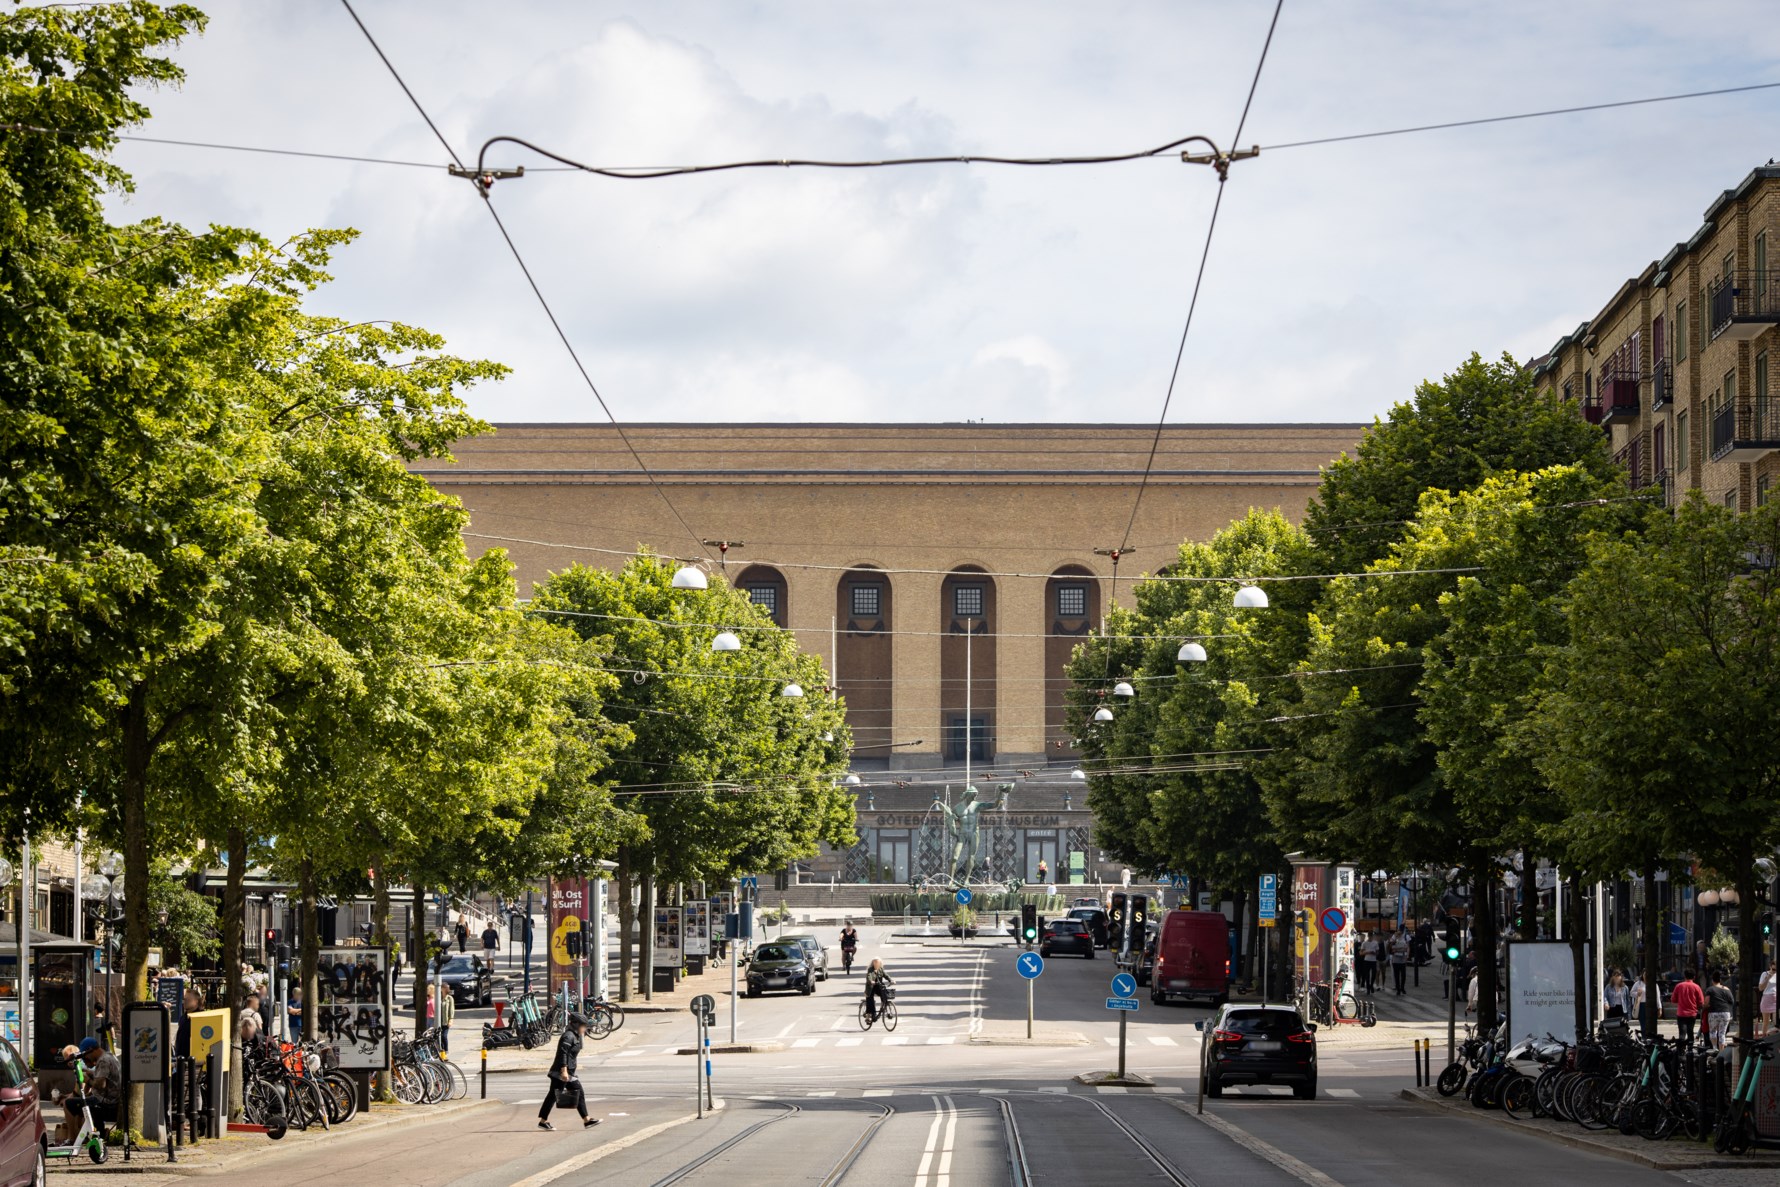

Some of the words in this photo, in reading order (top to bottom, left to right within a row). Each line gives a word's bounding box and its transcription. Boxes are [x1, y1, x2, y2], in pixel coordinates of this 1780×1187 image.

[877, 813, 945, 826] GÖTEBORG
[980, 815, 1059, 826] NSTMUSEUM
[1263, 875, 1274, 889] P
[1303, 882, 1318, 891] Ost
[566, 890, 582, 899] Ost
[552, 900, 558, 909] &
[559, 899, 582, 909] Surf!
[1113, 910, 1121, 921] S
[1135, 911, 1143, 922] S
[1523, 989, 1538, 997] Ride
[1538, 990, 1553, 999] your
[1553, 989, 1566, 997] bike
[1530, 999, 1548, 1008] might
[1548, 1000, 1557, 1008] get
